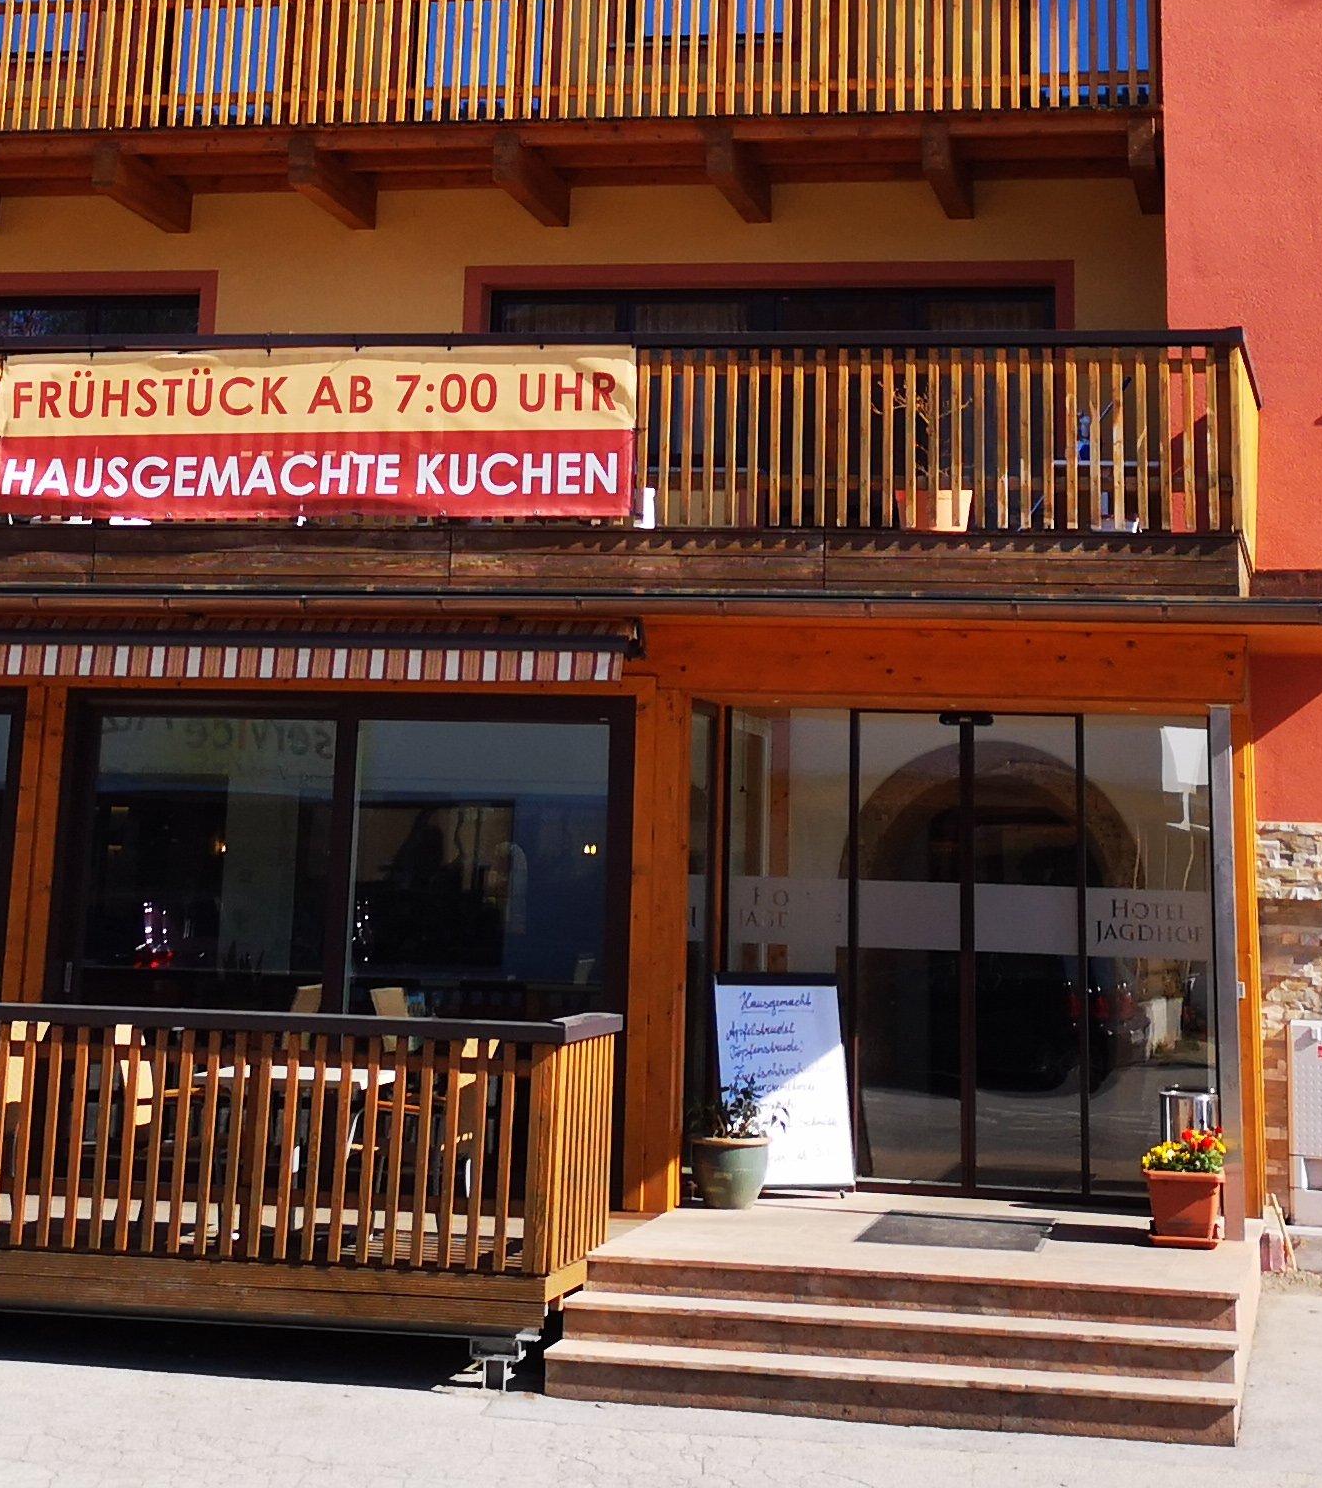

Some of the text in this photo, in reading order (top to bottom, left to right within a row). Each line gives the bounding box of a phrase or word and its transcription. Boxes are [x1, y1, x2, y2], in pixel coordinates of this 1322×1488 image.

[13, 368, 617, 418] FRÜHSTÜCK AB 7:00 UHR
[1, 452, 618, 498] HAUSGEMACHTE KUCHEN
